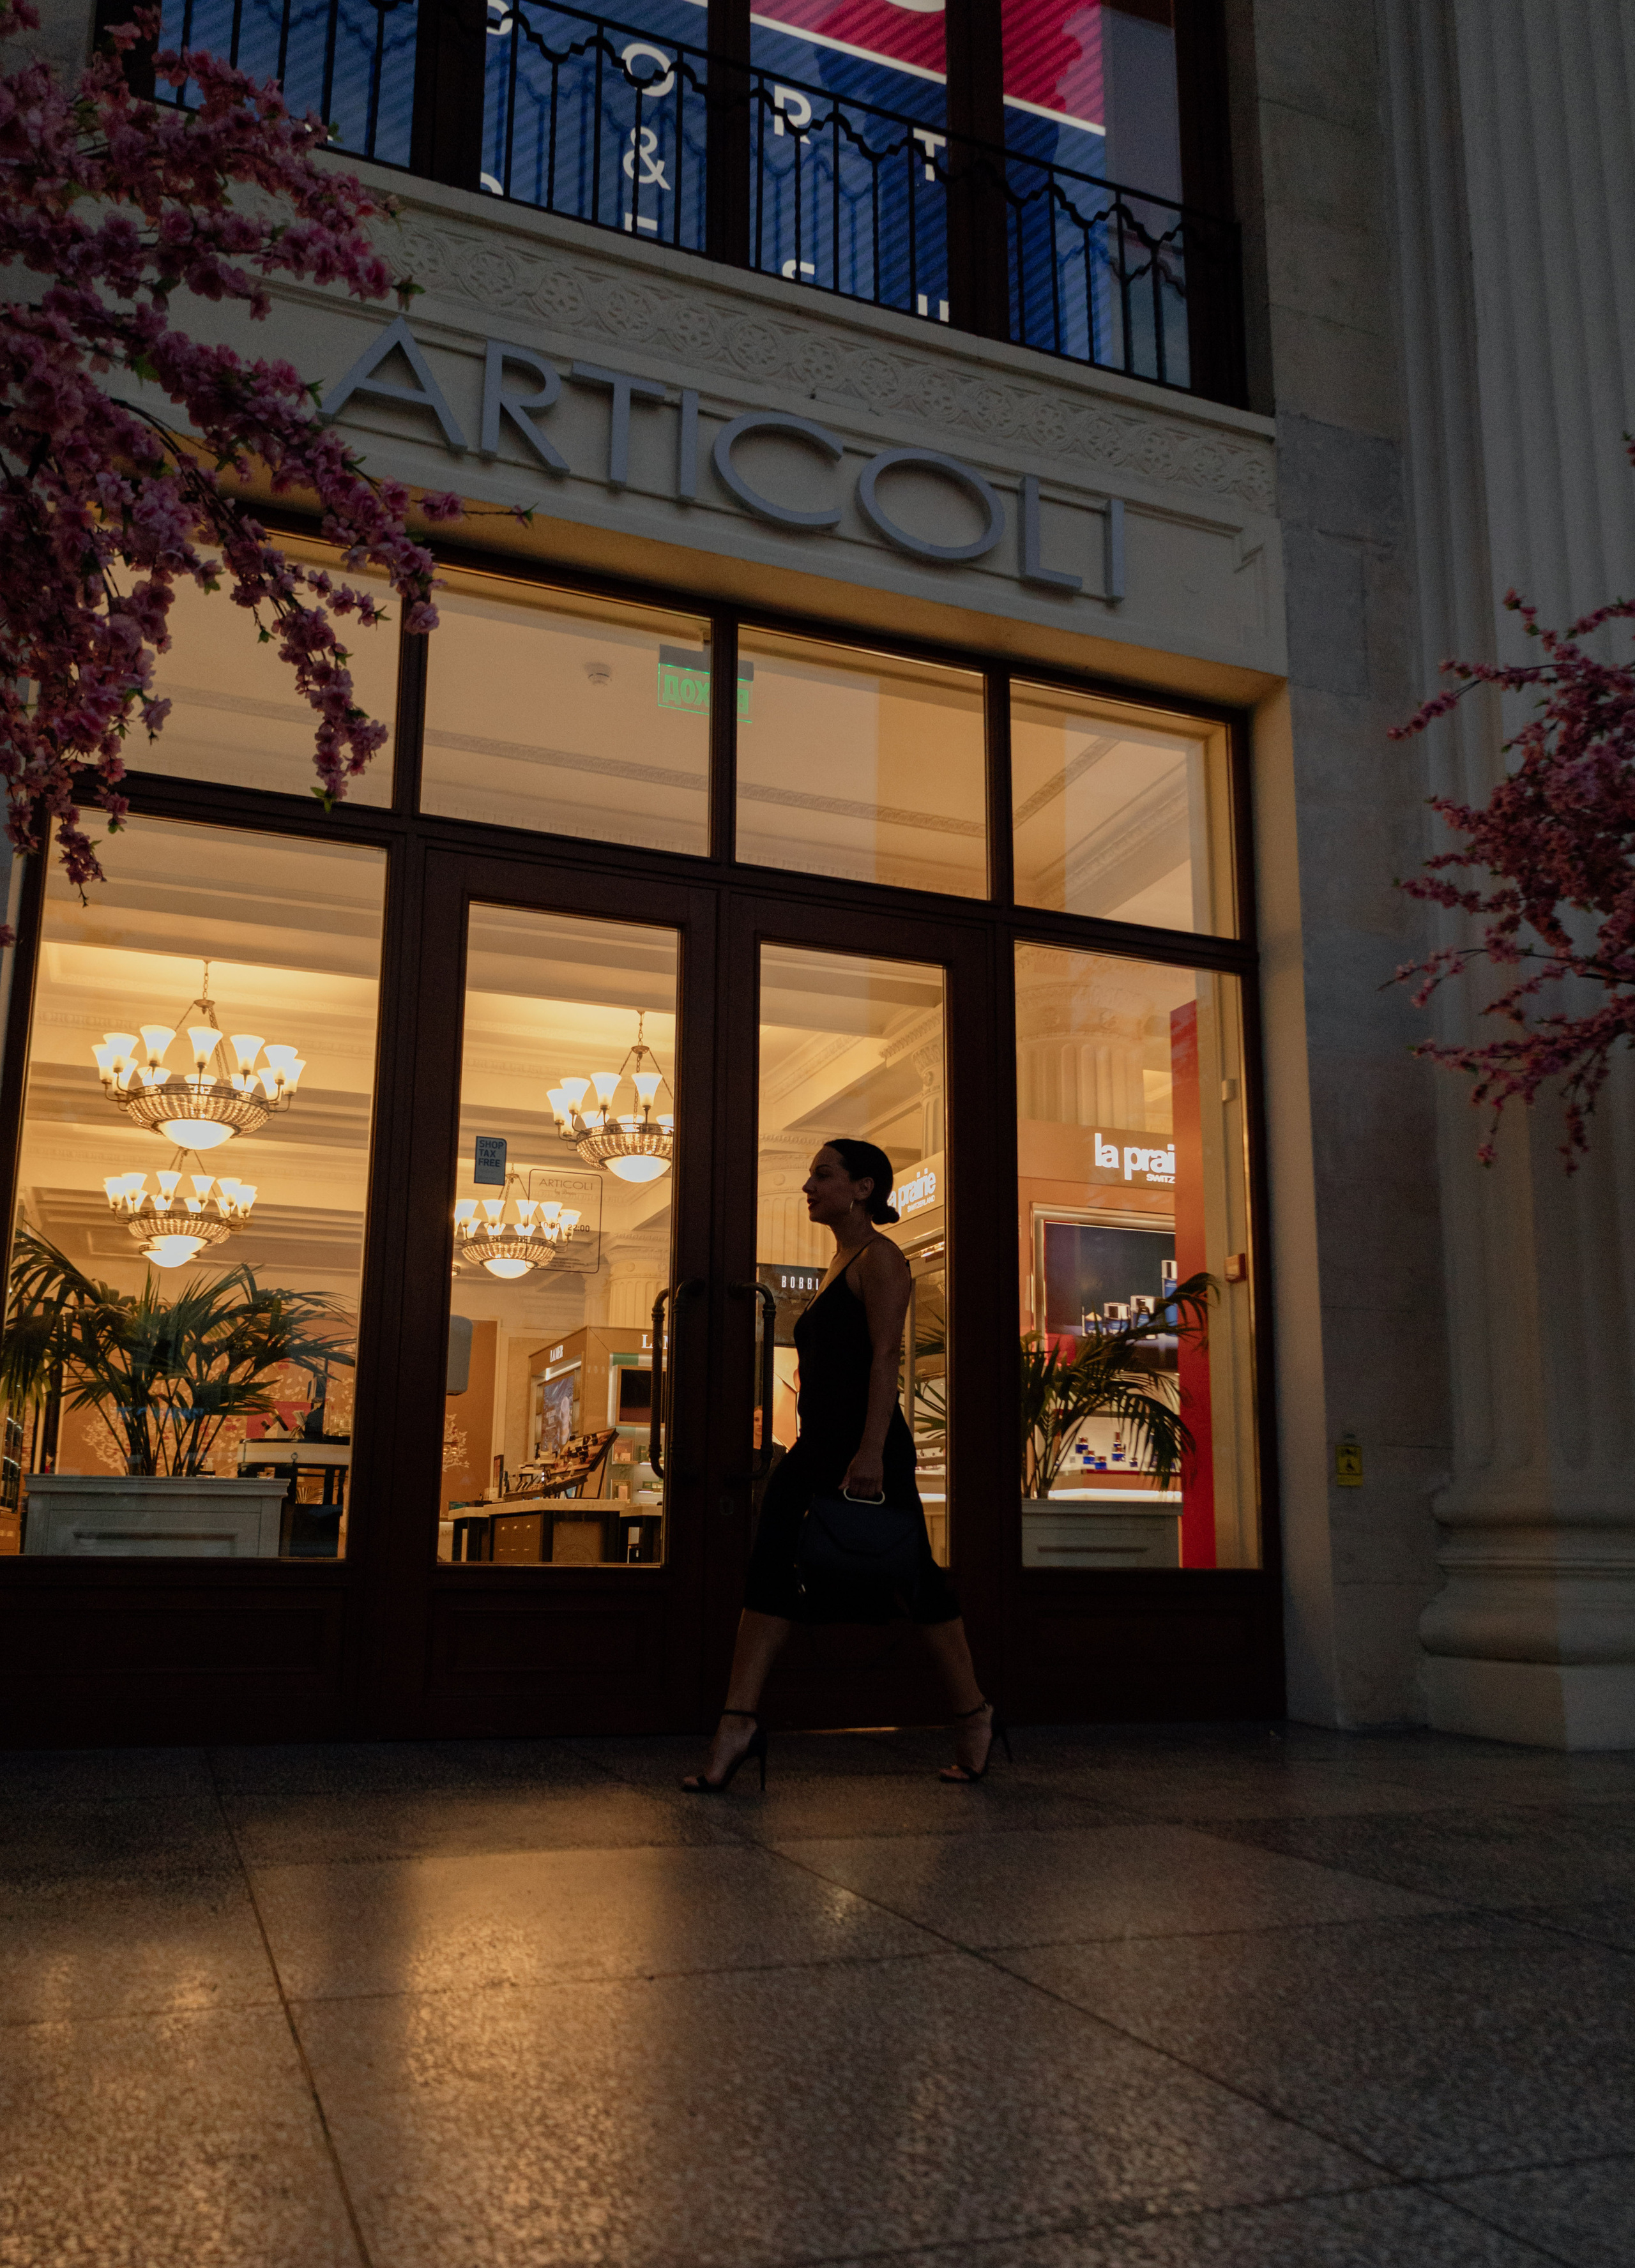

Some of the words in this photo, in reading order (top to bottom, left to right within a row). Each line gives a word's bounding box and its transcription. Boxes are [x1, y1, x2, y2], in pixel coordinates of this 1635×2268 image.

[318, 315, 1125, 604] ARTICOLI
[479, 1140, 504, 1150] SHOP
[478, 1149, 496, 1158] TAX
[1094, 1133, 1119, 1168] la
[1123, 1144, 1176, 1181] prai
[478, 1158, 501, 1167] FREE
[539, 1178, 593, 1190] ARTICOLI
[898, 1168, 936, 1217] prairie
[568, 1224, 590, 1232] 22:00
[781, 1275, 819, 1290] BOBBI
